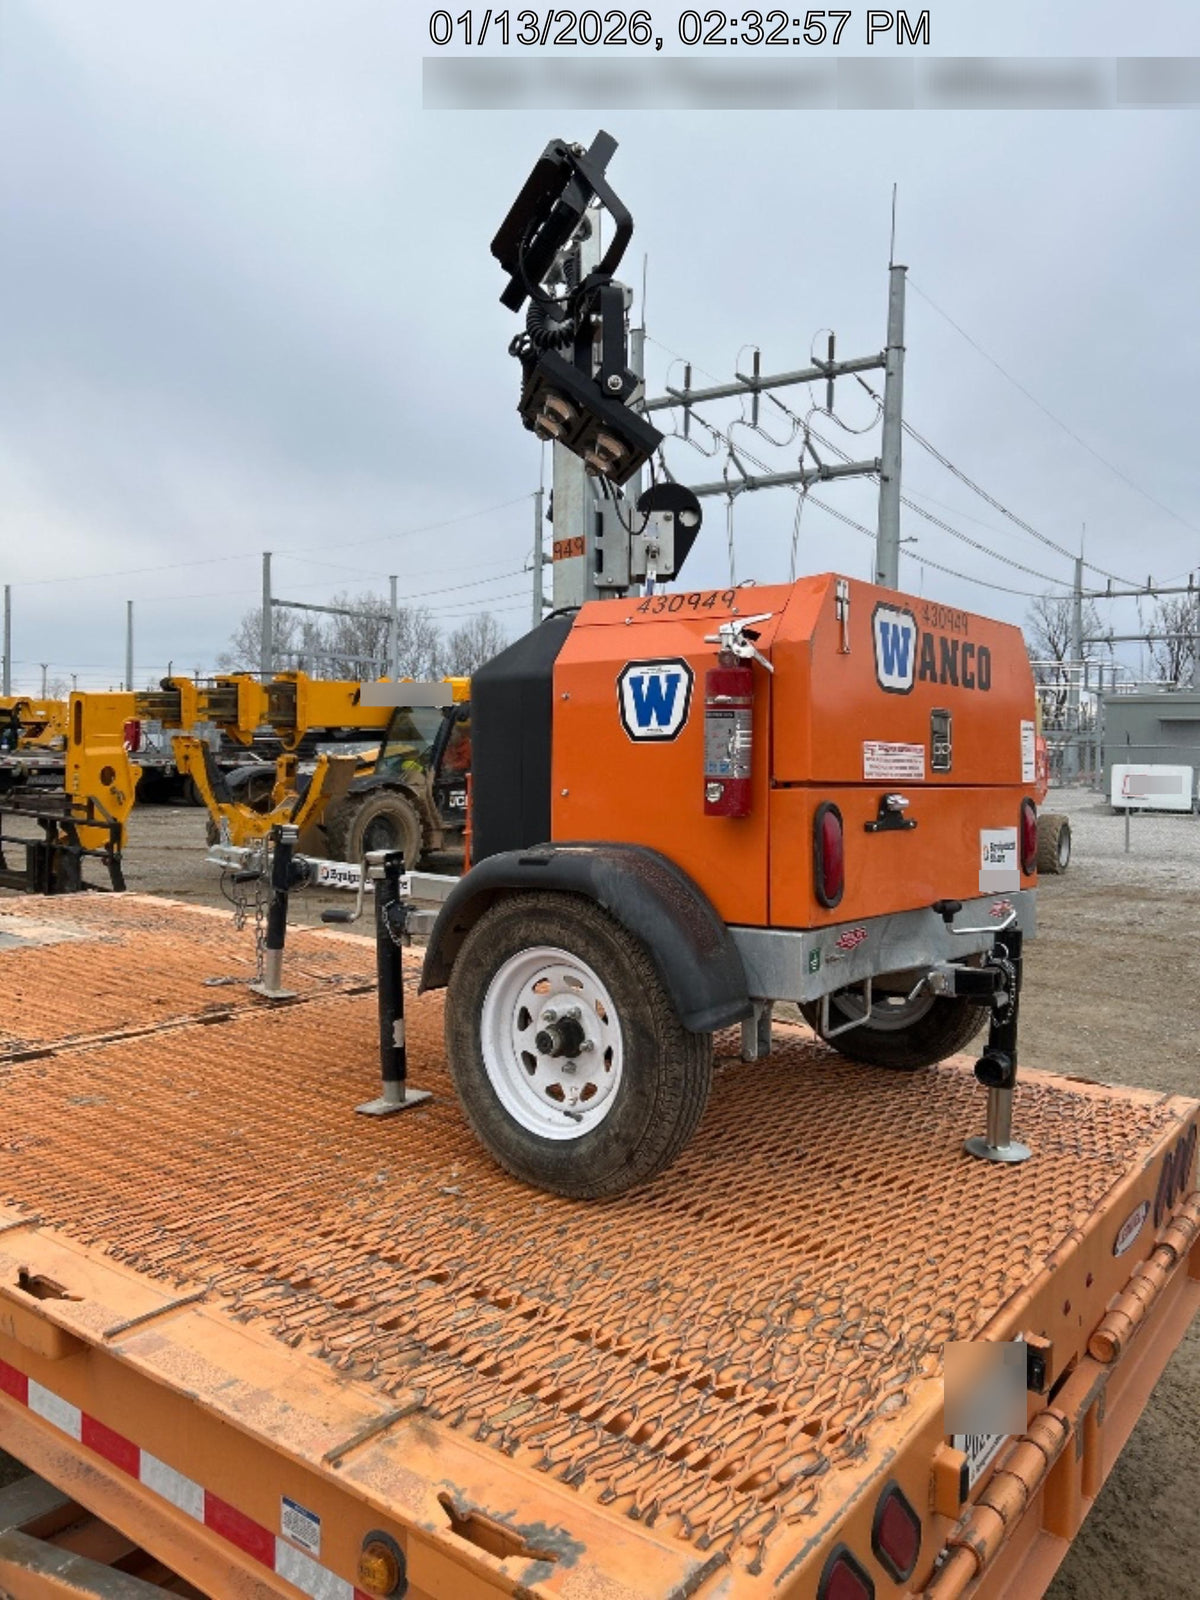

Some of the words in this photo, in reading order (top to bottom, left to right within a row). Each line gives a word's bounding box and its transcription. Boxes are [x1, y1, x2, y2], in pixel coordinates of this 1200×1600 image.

[637, 590, 736, 614] 430949
[922, 603, 969, 636] 430949
[879, 620, 992, 692] WANCO
[628, 673, 682, 728] W
[449, 795, 469, 807] JC
